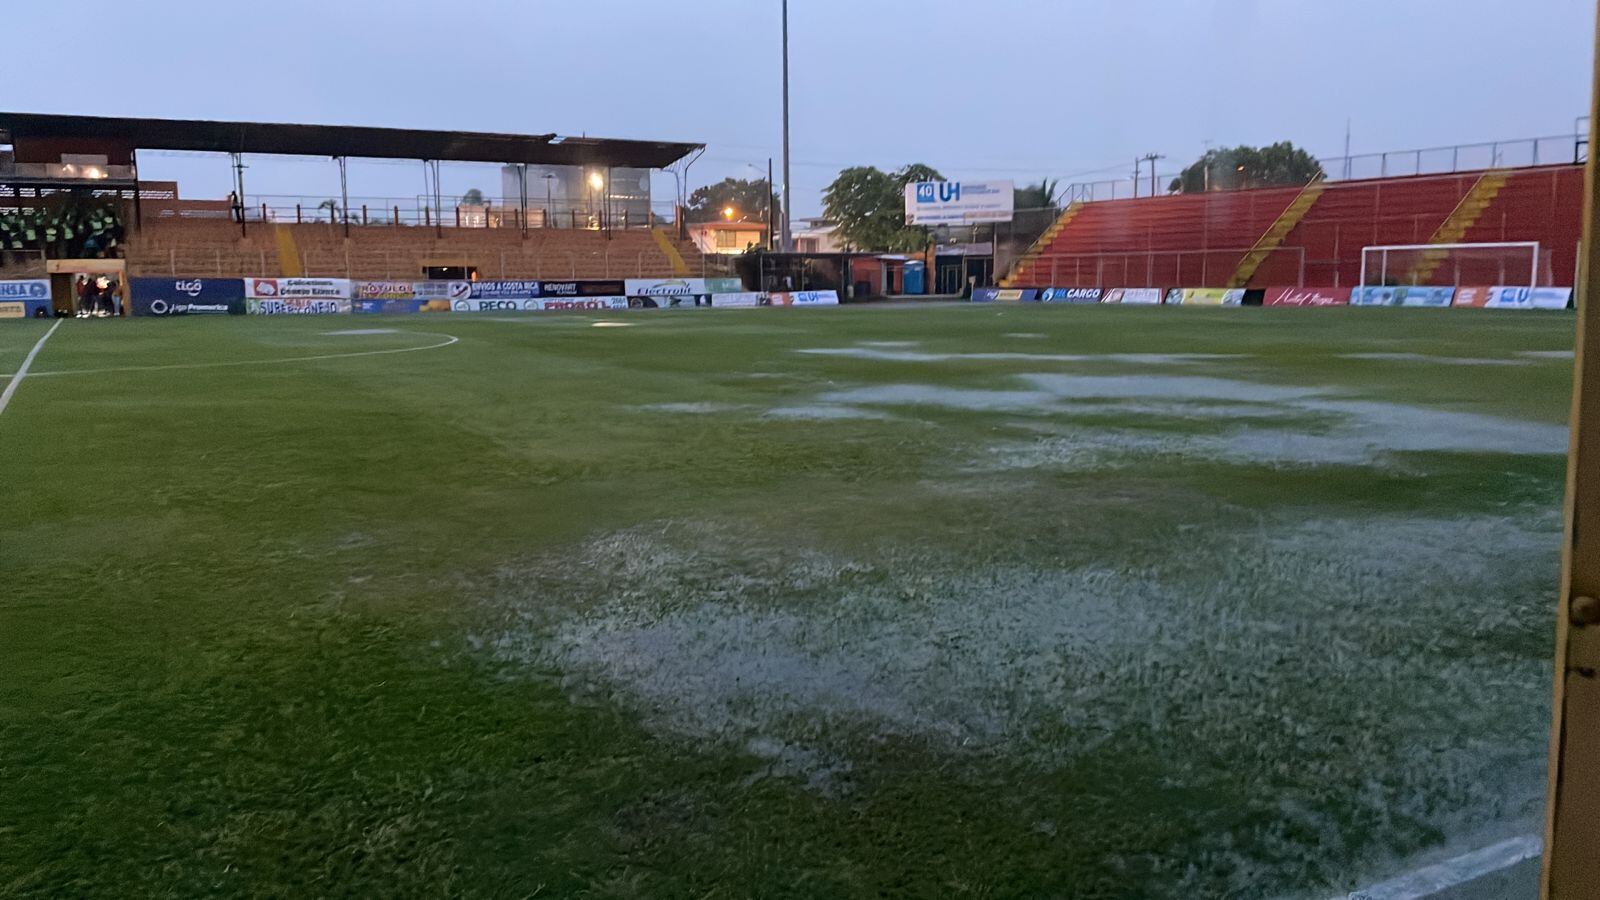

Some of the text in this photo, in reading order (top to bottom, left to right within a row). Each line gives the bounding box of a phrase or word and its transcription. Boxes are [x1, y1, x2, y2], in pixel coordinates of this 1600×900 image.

[939, 182, 960, 202] UH
[503, 282, 523, 291] COSTA
[524, 281, 539, 290] RICA
[1067, 288, 1101, 298] CARGO
